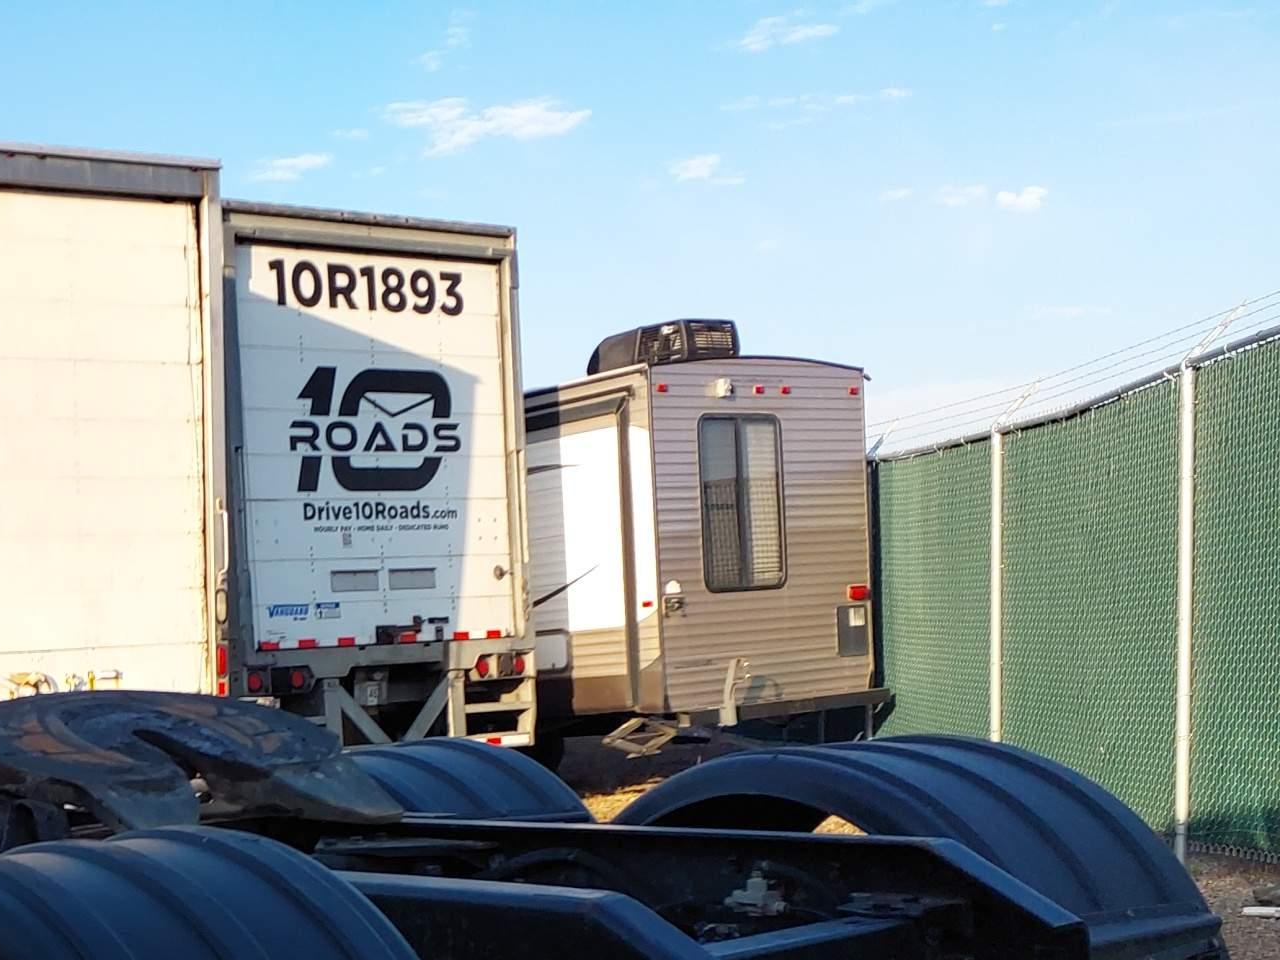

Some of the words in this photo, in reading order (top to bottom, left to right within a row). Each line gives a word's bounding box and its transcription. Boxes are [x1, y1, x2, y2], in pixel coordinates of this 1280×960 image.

[269, 258, 464, 316] 10R1893
[289, 420, 462, 452] ROADS
[303, 500, 458, 521] Drive10Roads.com
